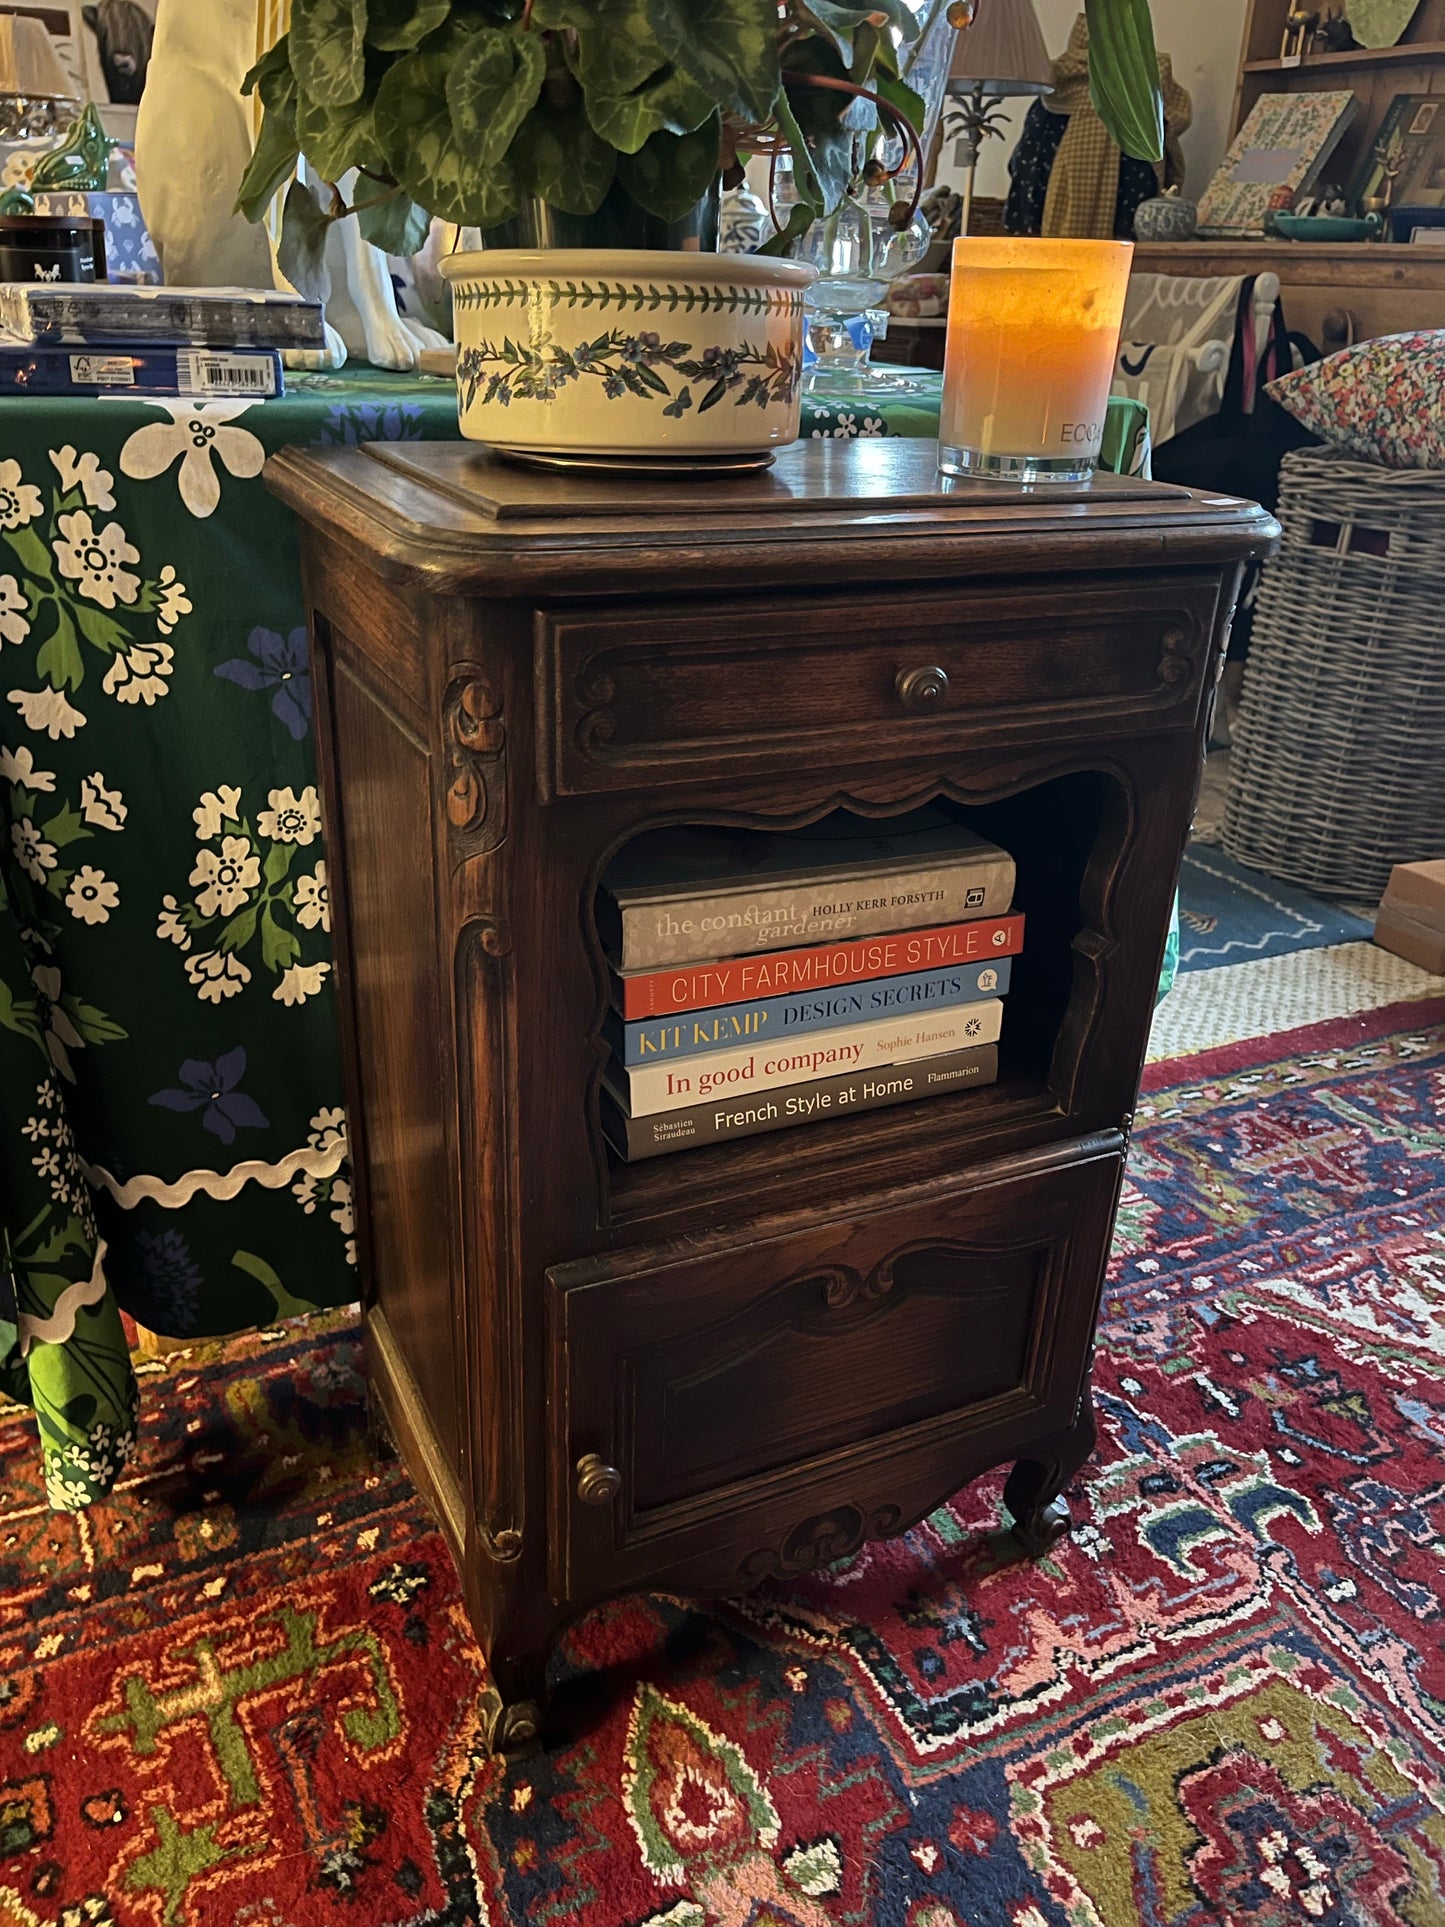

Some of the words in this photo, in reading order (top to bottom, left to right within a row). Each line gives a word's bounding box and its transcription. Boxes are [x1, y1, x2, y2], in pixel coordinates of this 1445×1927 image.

[1060, 423, 1101, 442] ECO
[812, 902, 853, 917] HOLLY
[856, 896, 888, 911] KERR
[890, 890, 945, 907] FORSYTH
[656, 913, 693, 937] the
[700, 904, 797, 931] constant
[756, 914, 857, 946] gardener
[672, 970, 731, 1003] CITY
[742, 943, 898, 991] FARMHOUSE
[906, 930, 979, 964] STYLE
[782, 995, 863, 1026] DESIGN
[870, 977, 962, 1009] SECRETS
[640, 1027, 687, 1055] KIT
[693, 1011, 768, 1044] KEMP
[876, 1037, 913, 1053] Sophie
[915, 1028, 956, 1044] Hansen
[666, 1073, 691, 1096] In
[698, 1057, 756, 1095] good
[764, 1043, 865, 1073] company
[927, 1065, 980, 1084] Flammarion
[714, 1102, 778, 1130] French
[785, 1092, 831, 1115] Style
[838, 1087, 856, 1103] at
[863, 1078, 914, 1100] Home
[653, 1118, 694, 1133] Sébastien
[653, 1126, 696, 1142] Siraudeau
